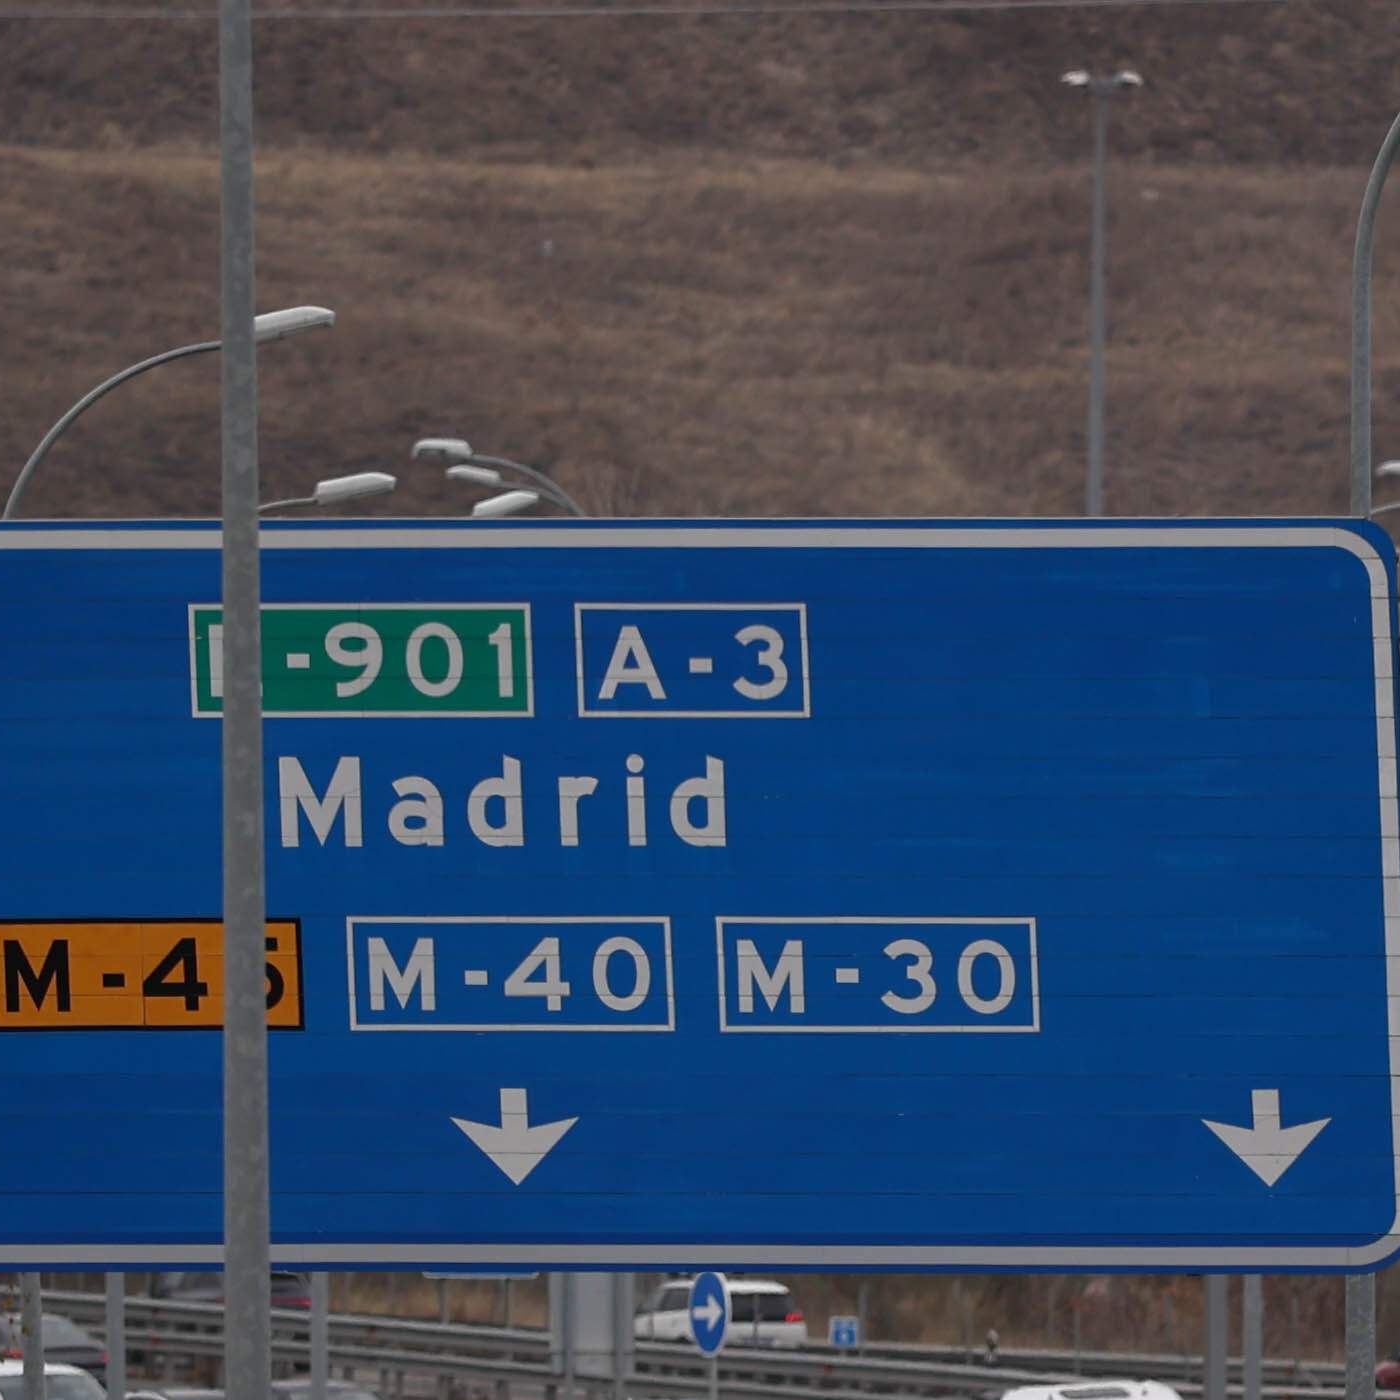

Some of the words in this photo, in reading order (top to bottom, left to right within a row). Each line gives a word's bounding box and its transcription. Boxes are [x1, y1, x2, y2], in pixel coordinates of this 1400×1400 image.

[598, 624, 788, 700] A-3
[278, 753, 727, 848] Madrid
[367, 936, 651, 1012] M-40
[736, 938, 1016, 1015] M-30
